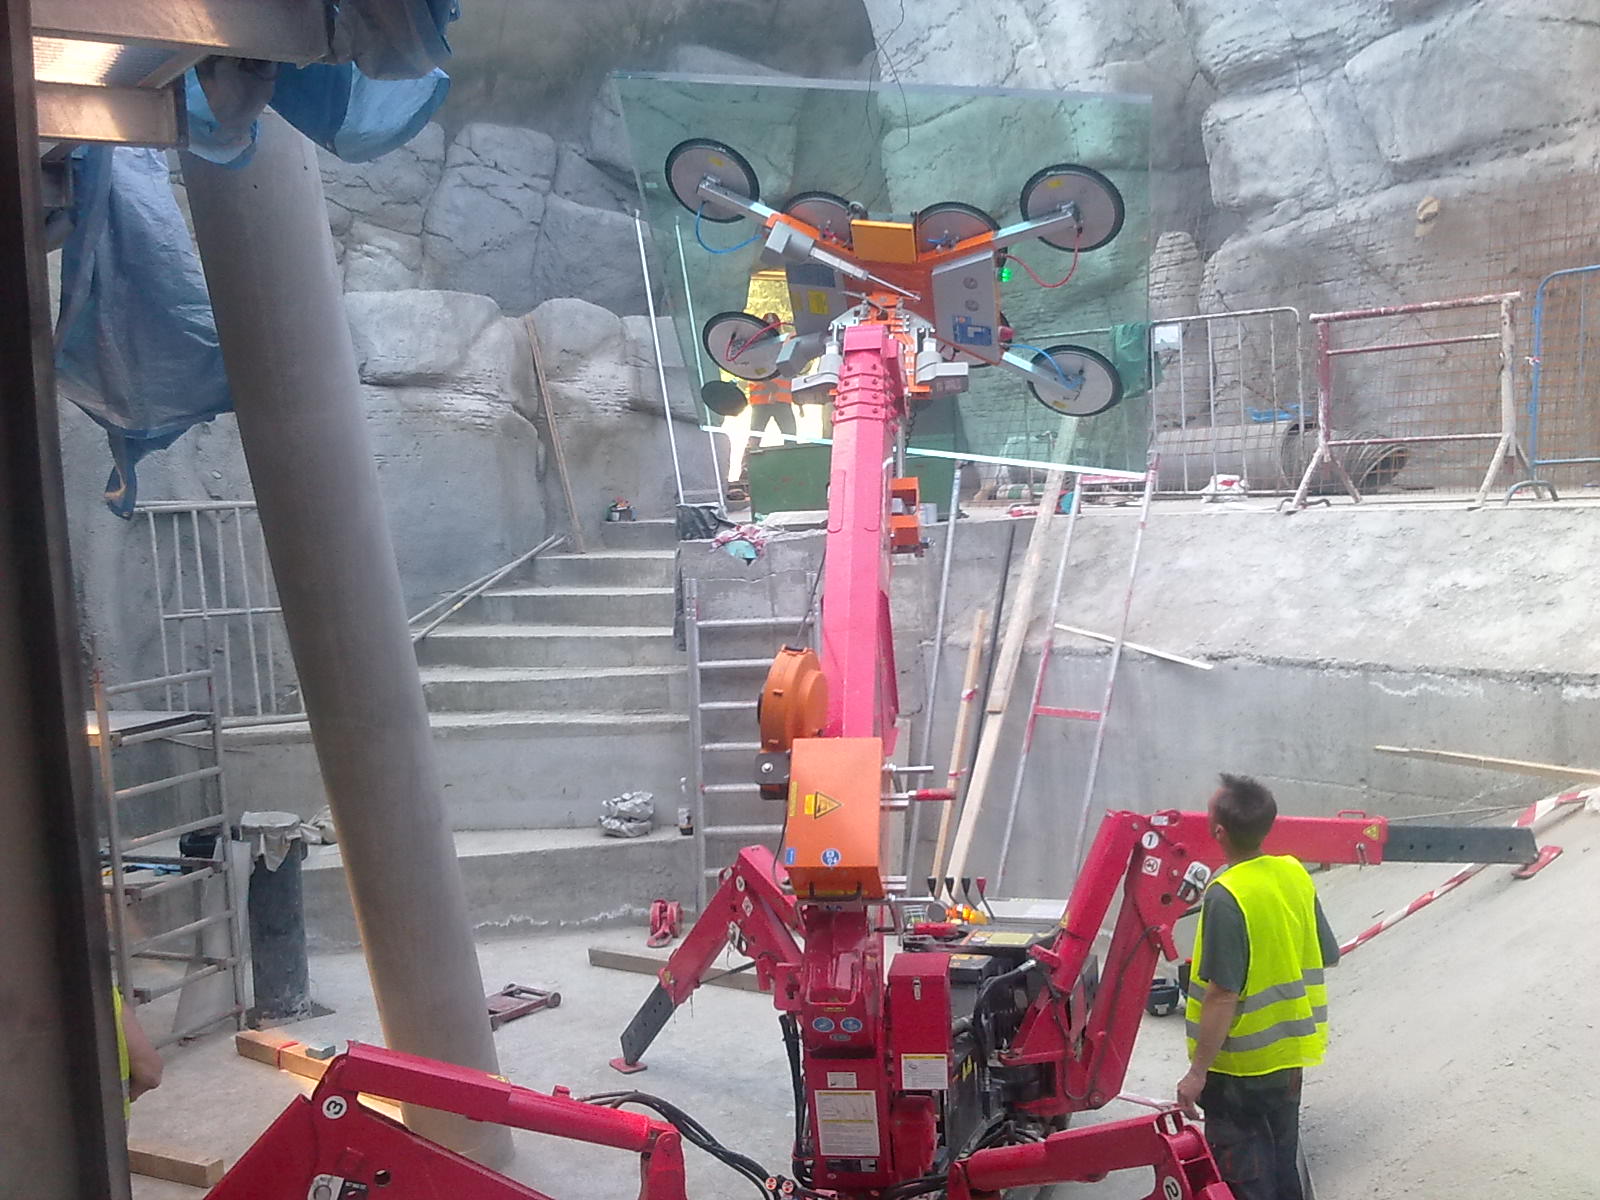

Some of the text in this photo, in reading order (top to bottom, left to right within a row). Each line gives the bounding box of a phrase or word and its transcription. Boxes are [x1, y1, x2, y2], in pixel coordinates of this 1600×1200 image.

[1147, 834, 1154, 847] 1
[326, 1100, 344, 1115] 3
[1165, 1181, 1179, 1200] 2
